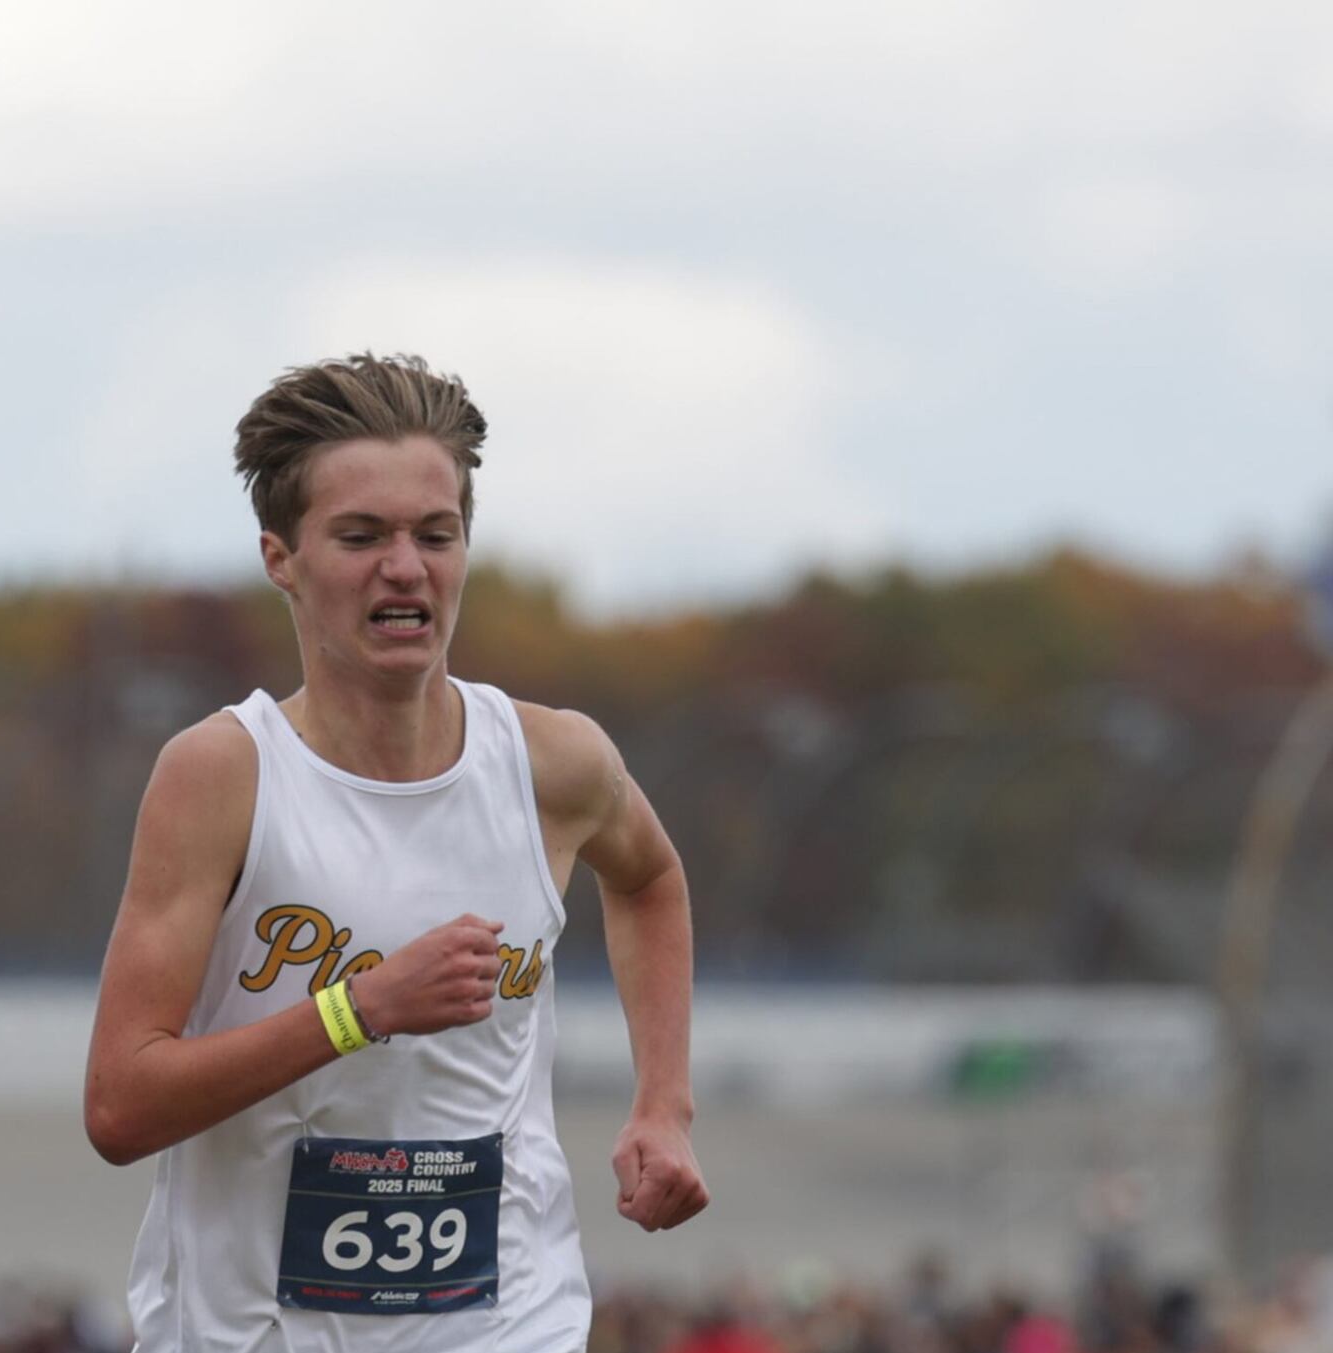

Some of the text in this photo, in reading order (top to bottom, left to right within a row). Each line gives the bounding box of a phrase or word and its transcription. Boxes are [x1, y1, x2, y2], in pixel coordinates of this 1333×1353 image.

[239, 904, 547, 1000] Pirs
[414, 1151, 464, 1163] CROSS
[413, 1161, 478, 1177] COUNTRY
[367, 1179, 446, 1193] 2025 FINAL
[322, 1207, 467, 1273] 639
